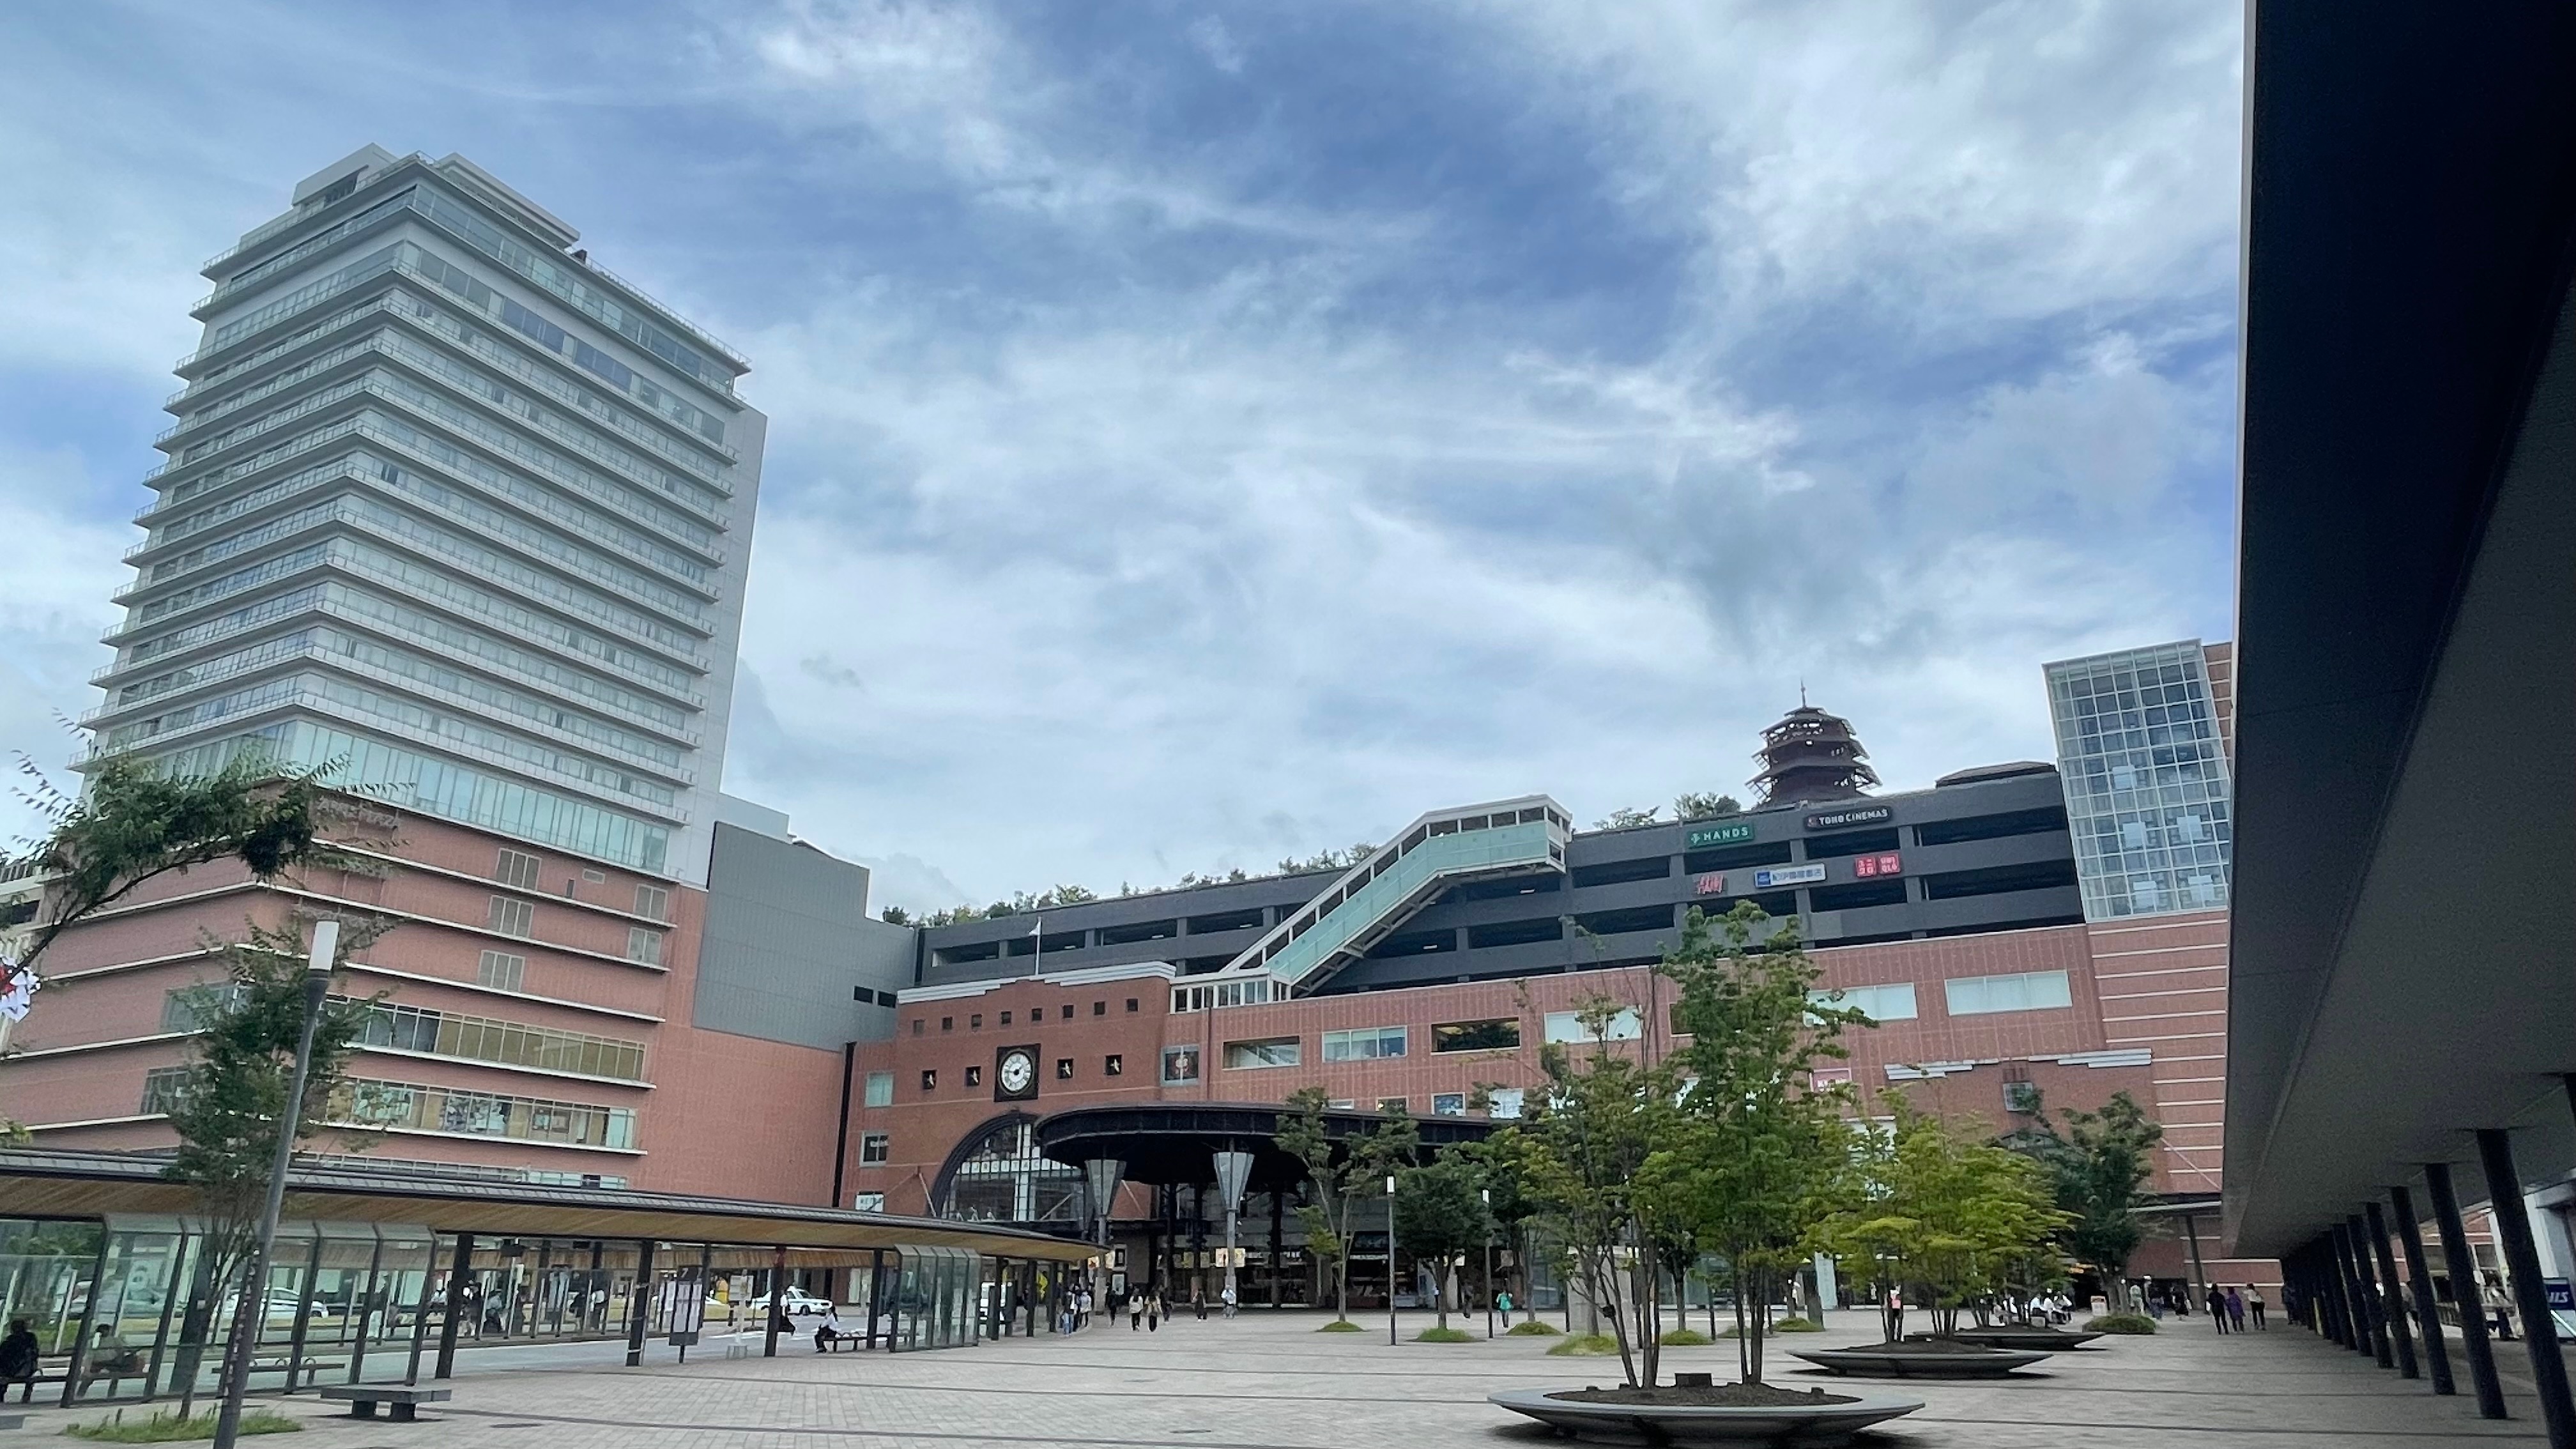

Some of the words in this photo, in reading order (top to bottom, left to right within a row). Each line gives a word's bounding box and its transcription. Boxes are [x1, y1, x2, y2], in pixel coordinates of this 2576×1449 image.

[1819, 815, 1844, 825] TOHO
[1845, 809, 1888, 822] CINEMAS
[1703, 827, 1749, 841] HANDS
